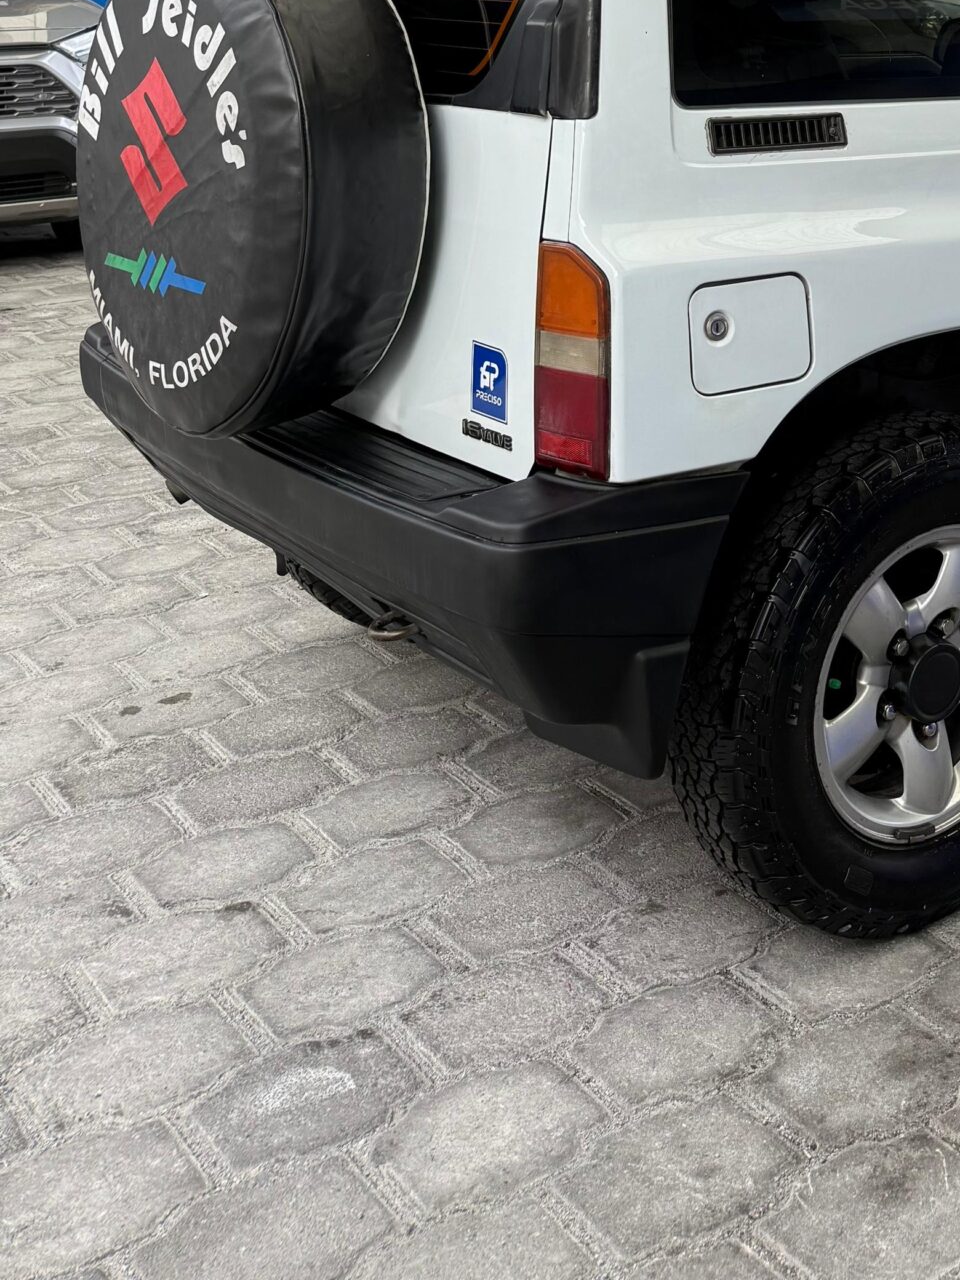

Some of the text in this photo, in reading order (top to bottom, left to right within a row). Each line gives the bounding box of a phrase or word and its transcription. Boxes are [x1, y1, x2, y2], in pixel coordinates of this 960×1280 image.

[78, 0, 125, 141] Bill
[149, 315, 238, 389] FLORIDA
[475, 389, 502, 407] PRECISO
